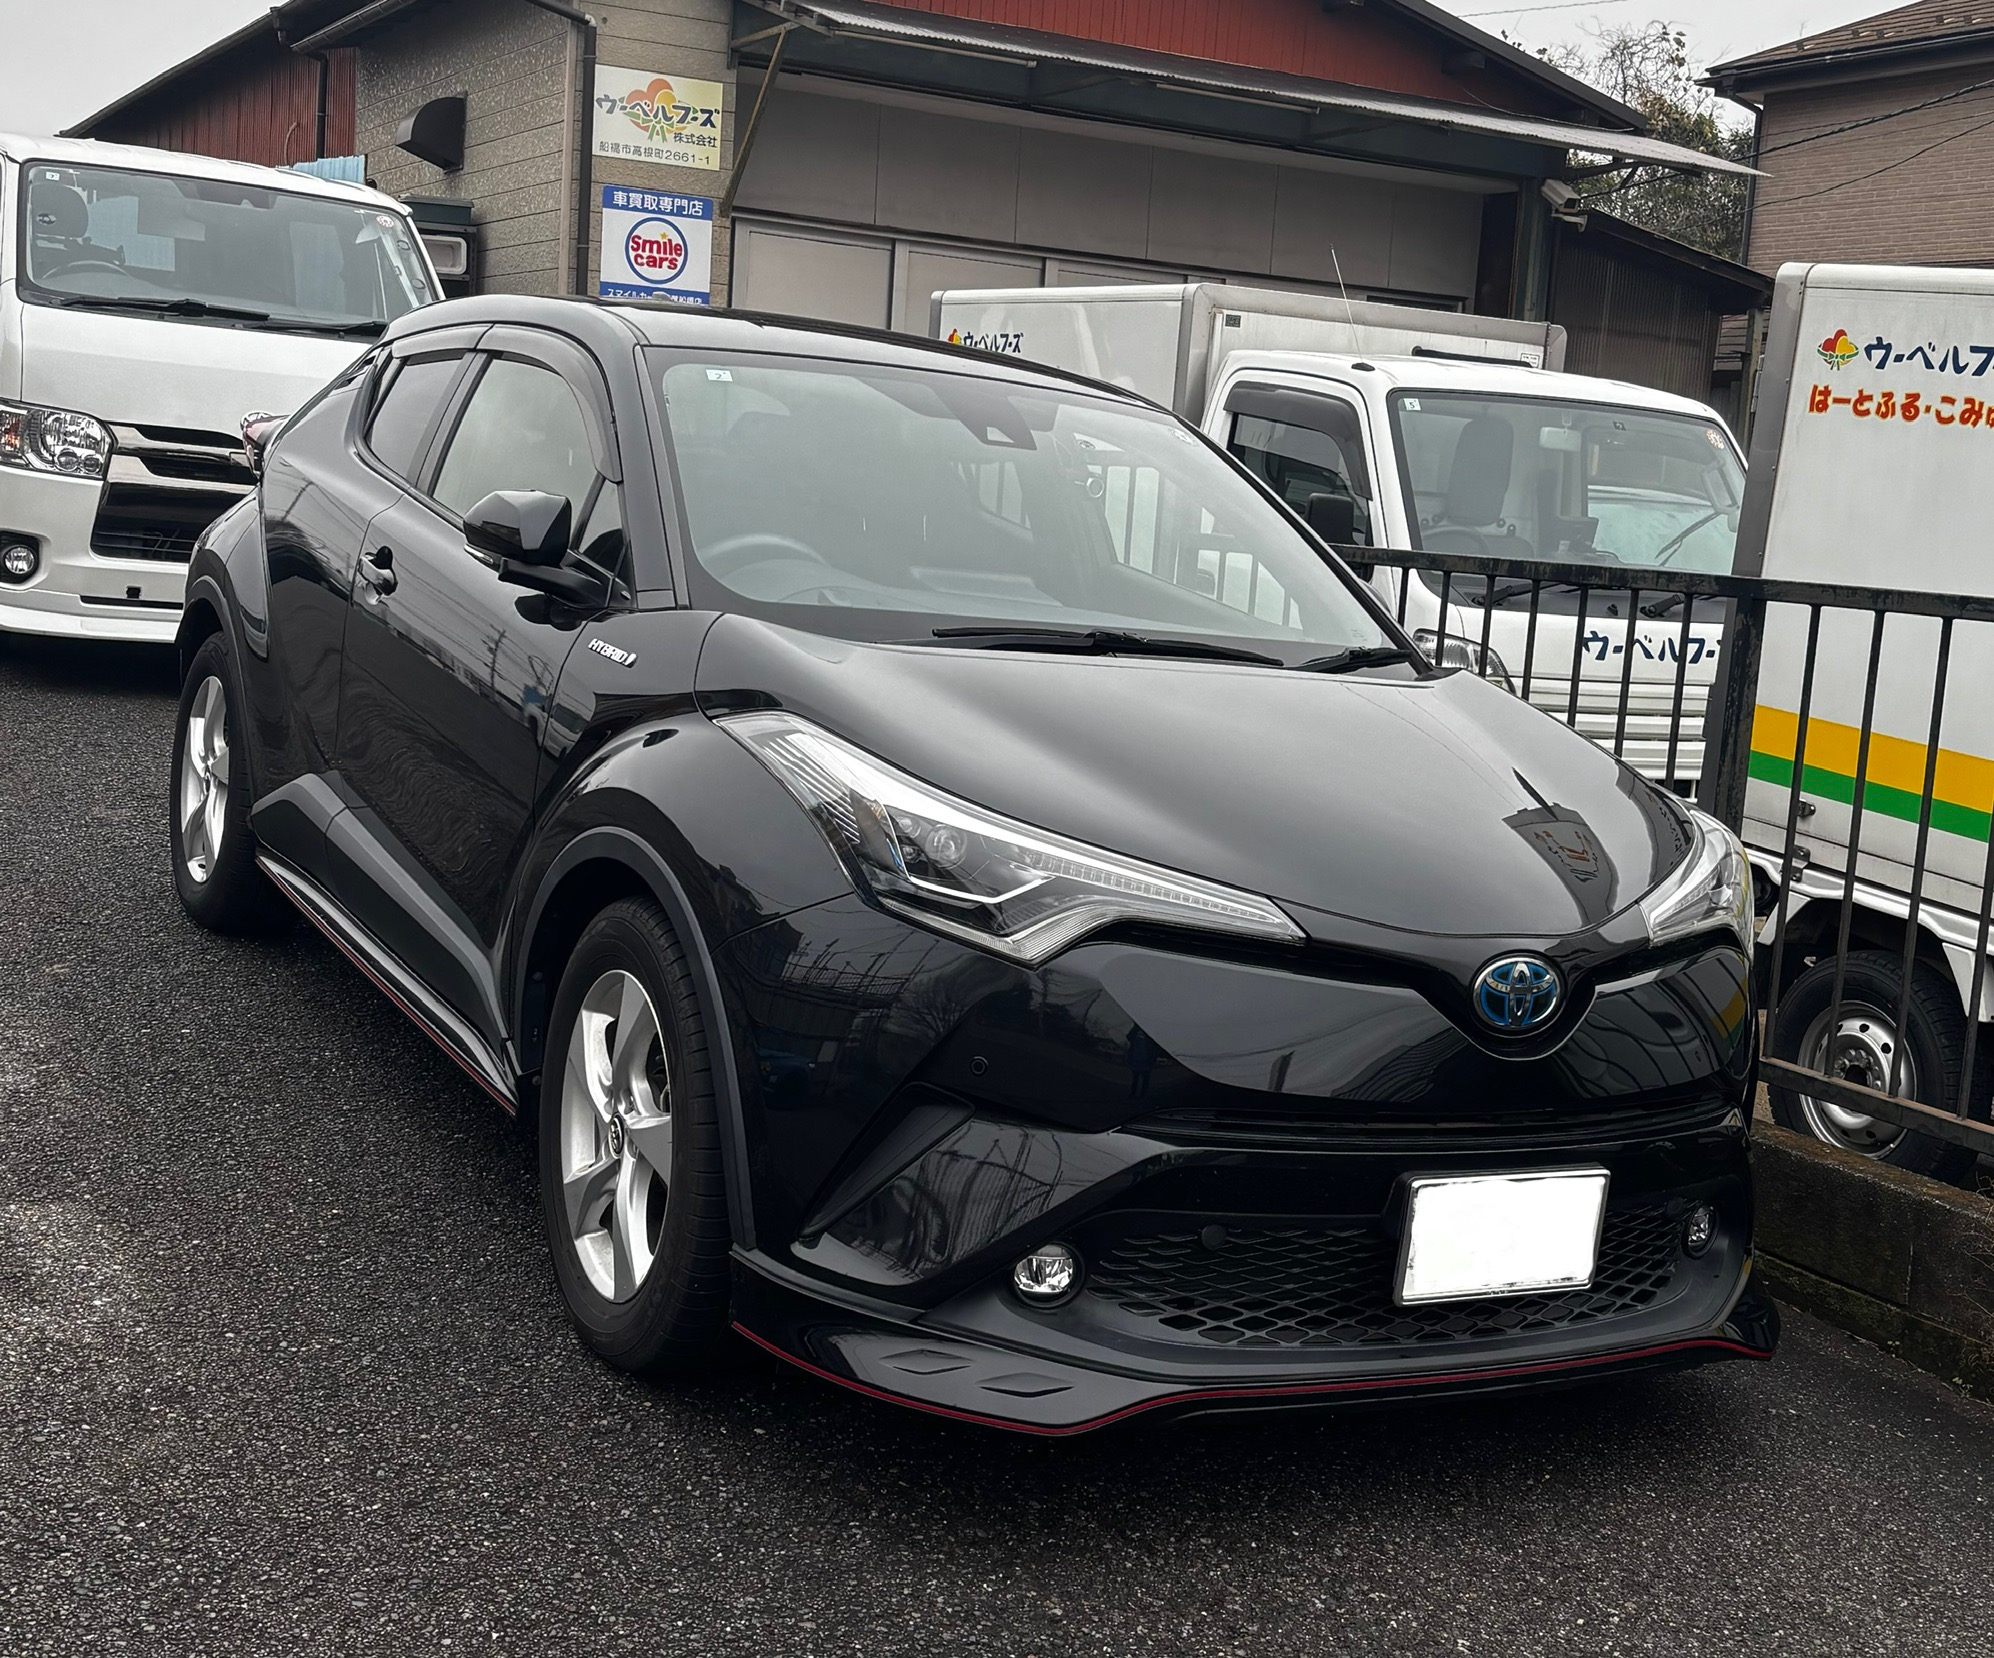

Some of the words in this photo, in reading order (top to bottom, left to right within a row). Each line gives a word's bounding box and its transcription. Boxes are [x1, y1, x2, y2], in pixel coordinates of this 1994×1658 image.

[673, 132, 717, 148] 株式会社
[613, 191, 703, 216] 車買取専門店
[634, 254, 678, 270] cars
[1864, 336, 1994, 376] ウーベルフ
[588, 638, 629, 663] HYBRID
